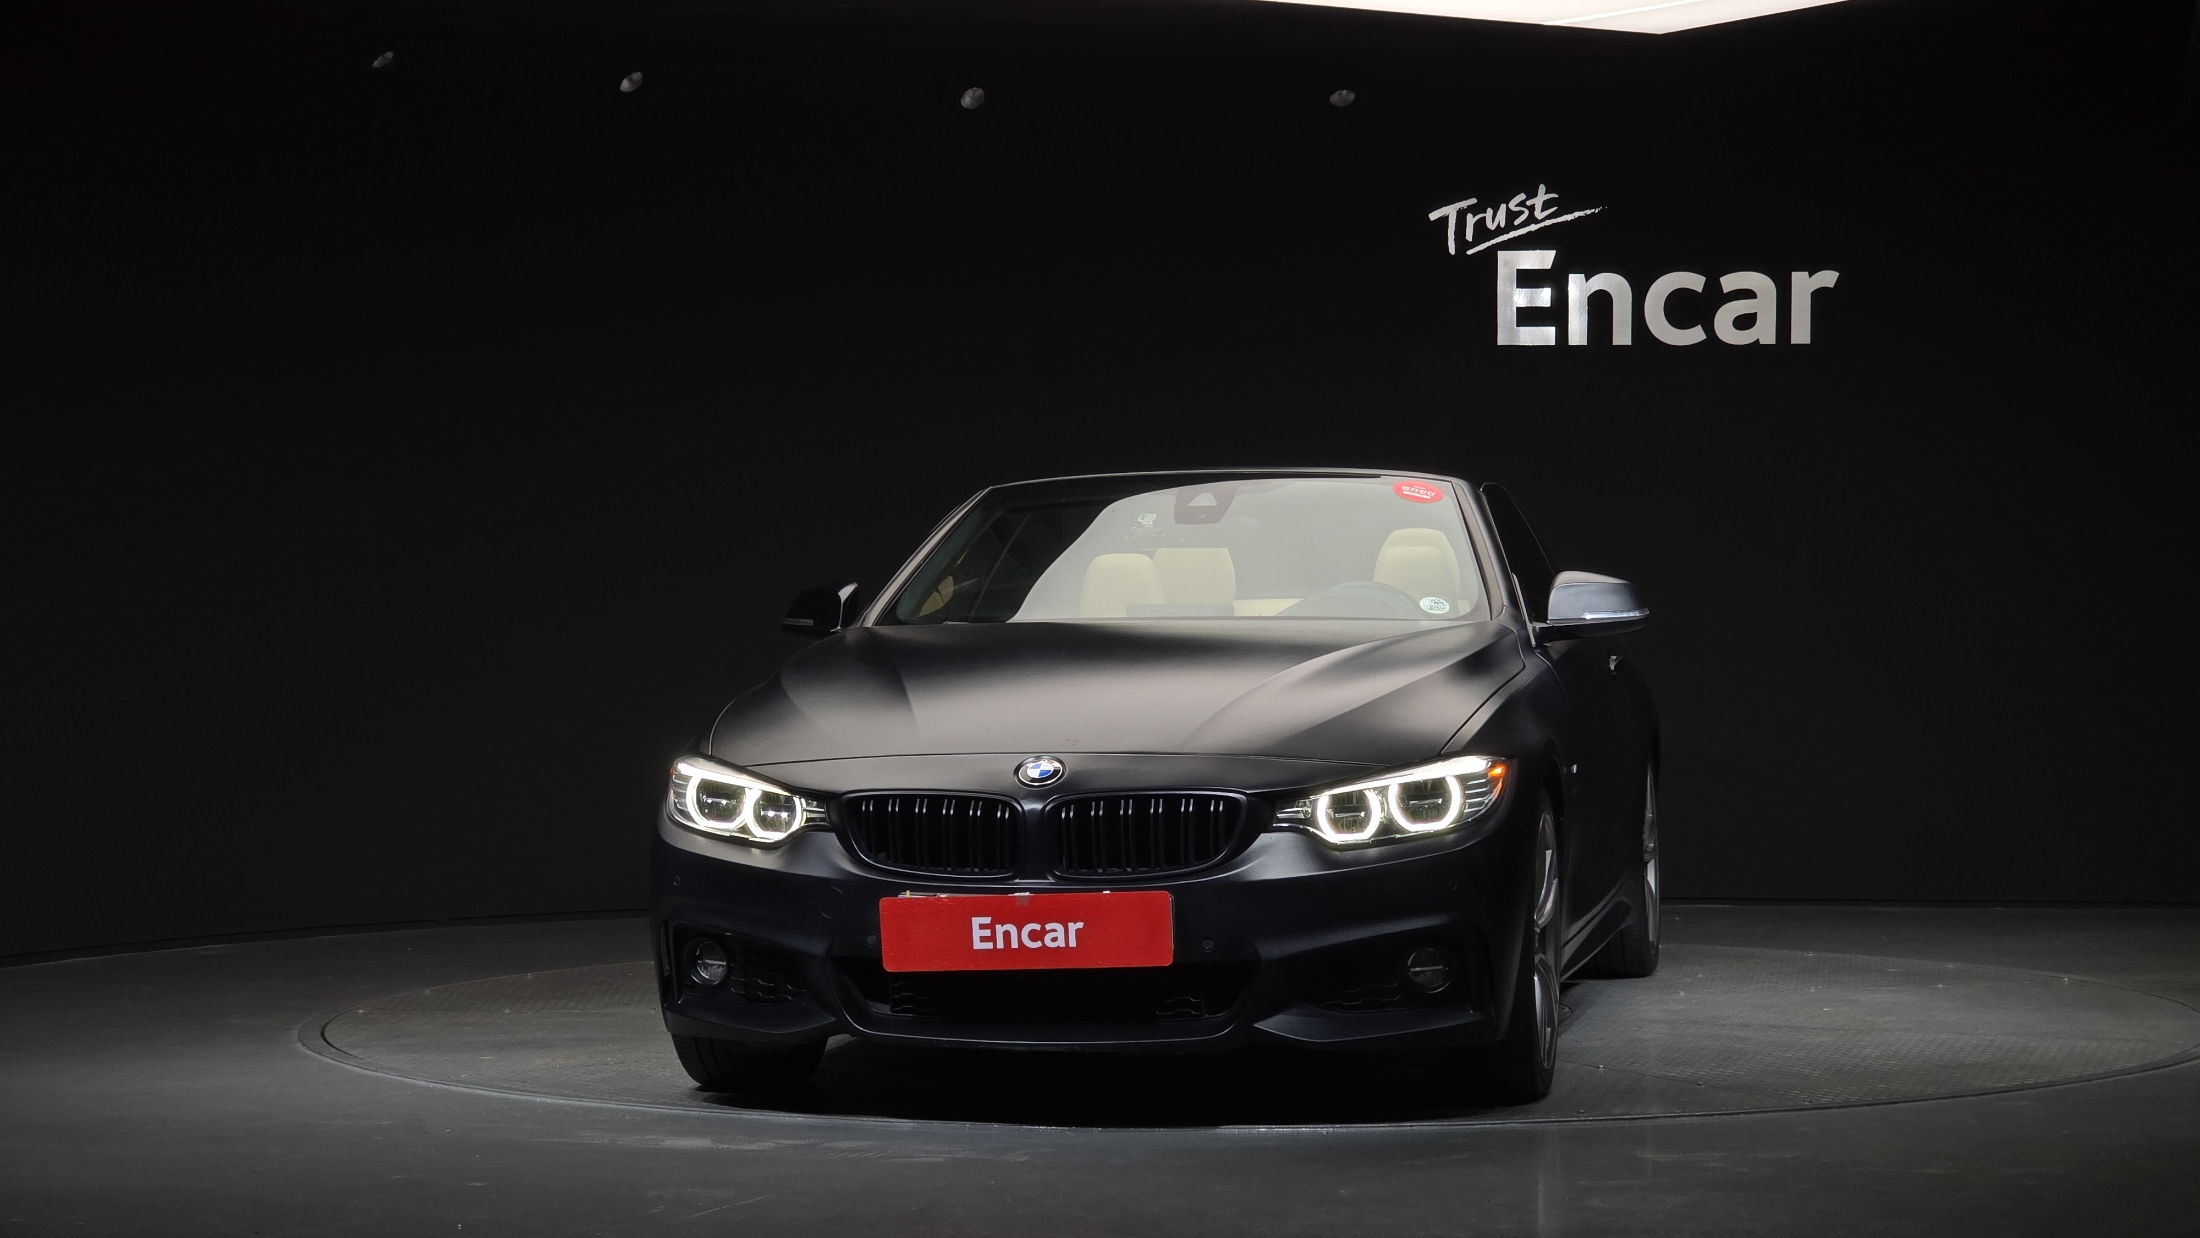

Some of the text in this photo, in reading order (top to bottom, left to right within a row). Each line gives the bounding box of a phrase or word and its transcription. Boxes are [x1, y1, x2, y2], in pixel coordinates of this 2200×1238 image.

[1429, 184, 1560, 255] Trust
[1496, 249, 1840, 346] Encar
[971, 916, 1085, 950] Encar
